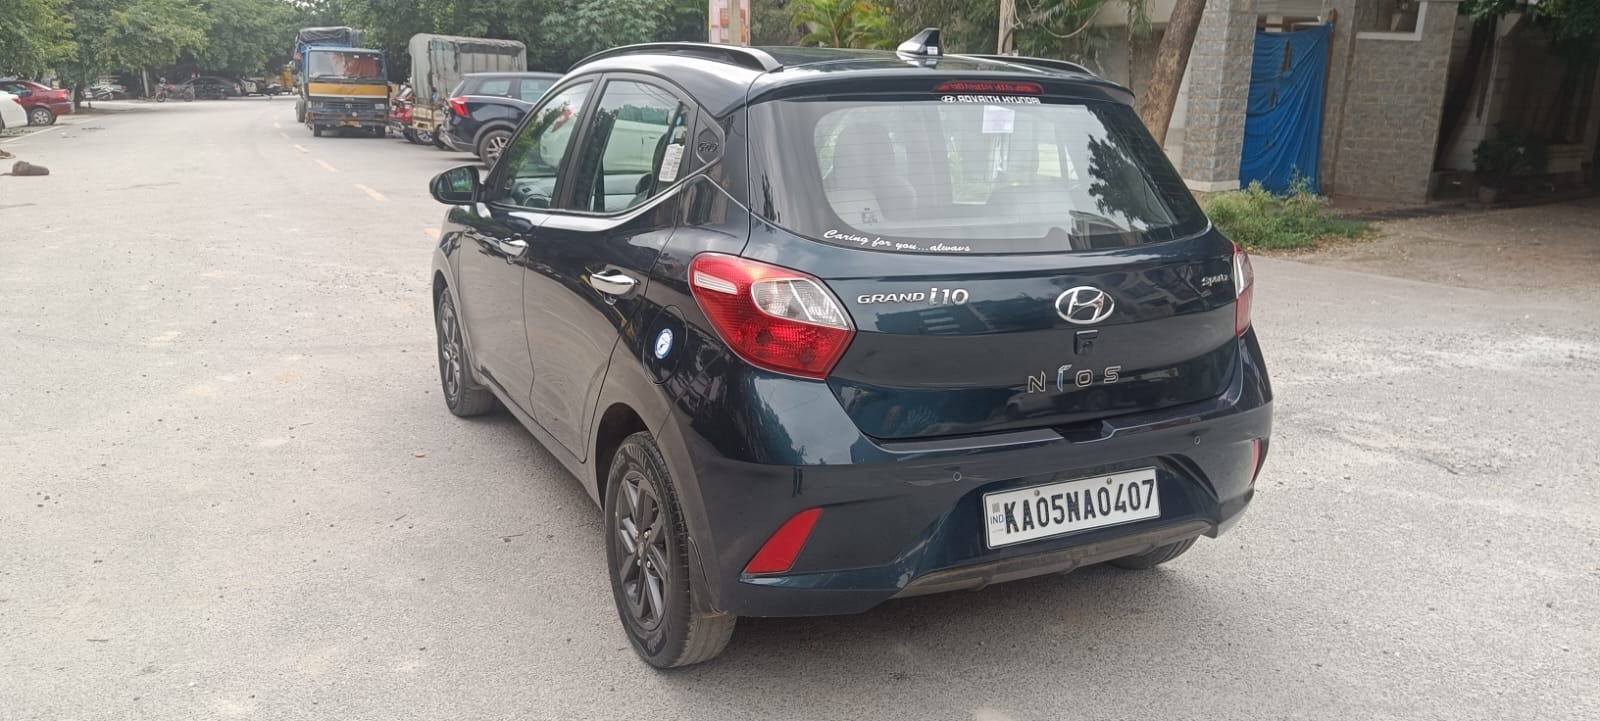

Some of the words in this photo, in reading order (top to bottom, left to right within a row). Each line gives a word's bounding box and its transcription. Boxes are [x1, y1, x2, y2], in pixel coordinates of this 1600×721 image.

[1003, 96, 1041, 104] HYUNDAI
[823, 229, 869, 245] Caring
[871, 237, 892, 247] for
[857, 292, 925, 304] GRAND
[928, 287, 969, 305] i10
[990, 514, 1004, 525] IND
[1004, 478, 1155, 534] KA05NA0407
